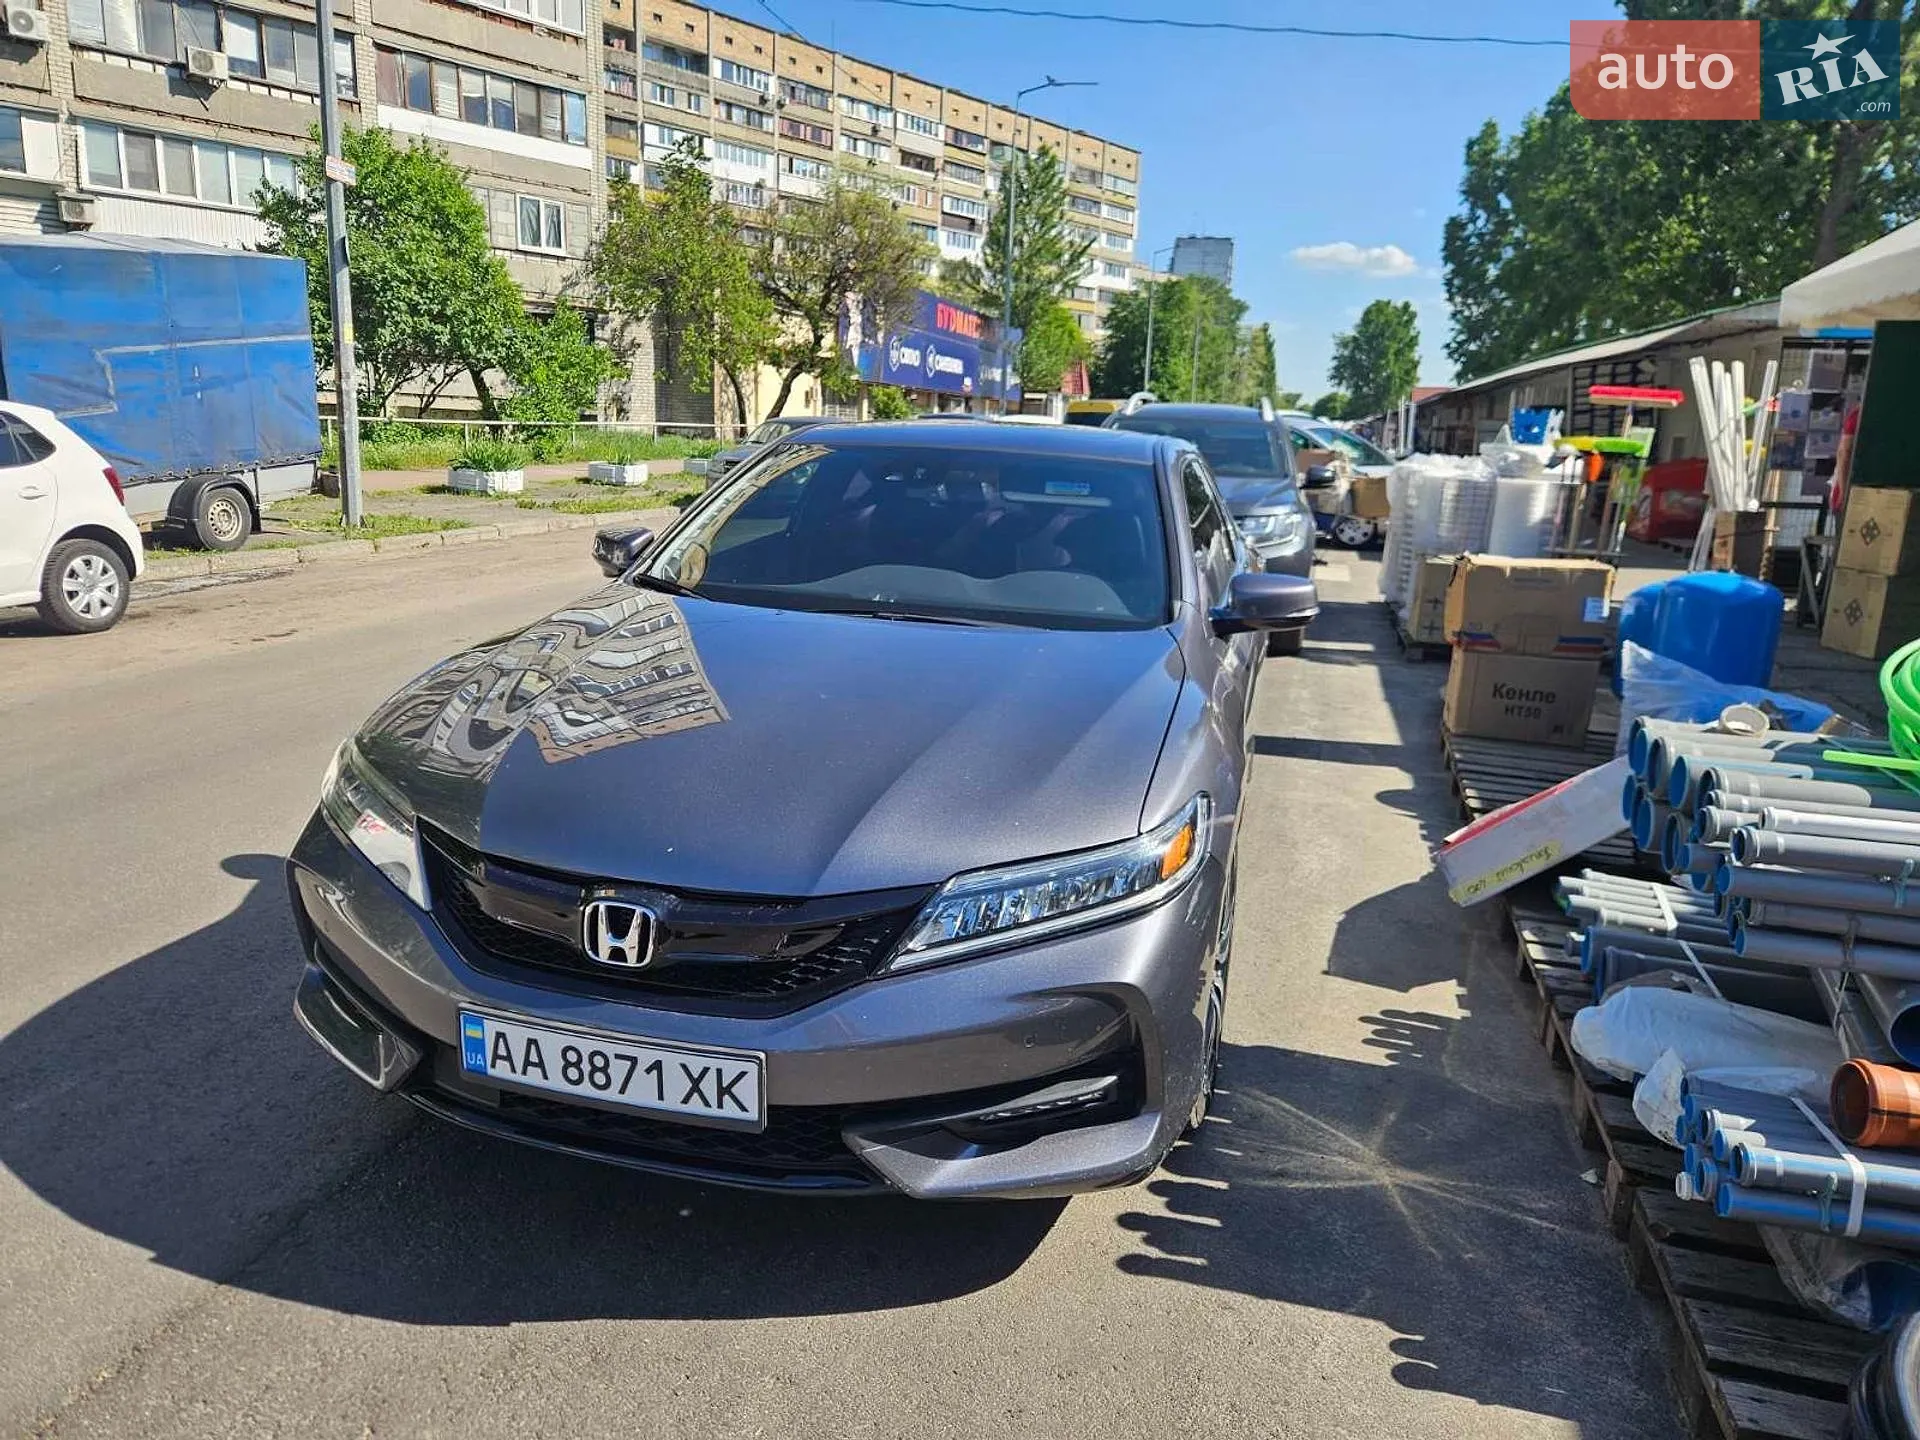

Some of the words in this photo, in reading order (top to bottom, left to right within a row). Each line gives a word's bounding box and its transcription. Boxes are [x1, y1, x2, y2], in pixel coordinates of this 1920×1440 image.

[467, 1051, 485, 1066] UA
[490, 1031, 549, 1080] AA
[561, 1045, 665, 1101] 8871
[680, 1062, 749, 1113] XK
